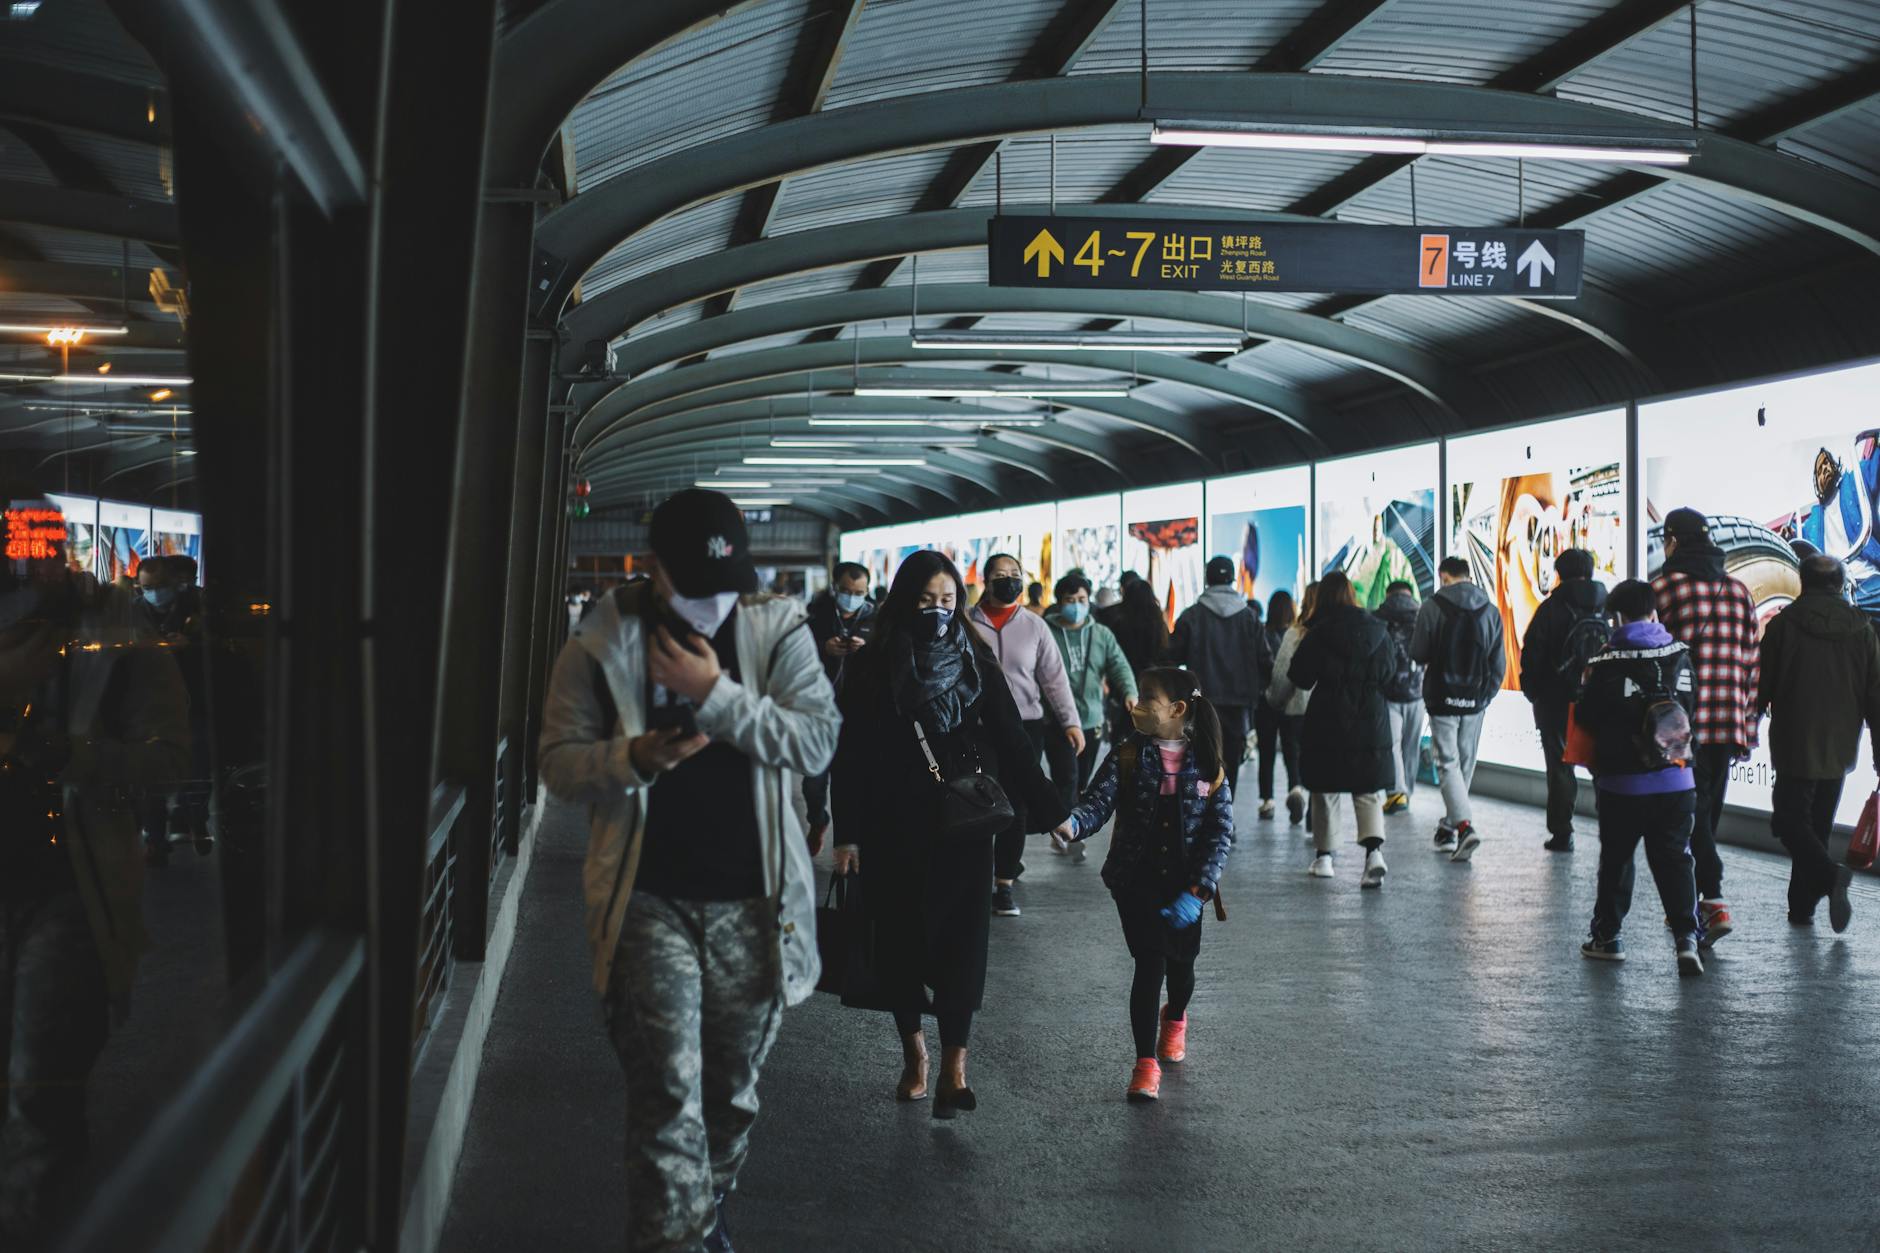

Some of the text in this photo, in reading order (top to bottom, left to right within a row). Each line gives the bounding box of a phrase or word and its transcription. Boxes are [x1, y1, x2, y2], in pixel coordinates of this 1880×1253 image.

[1162, 233, 1212, 261] 出口
[1221, 235, 1262, 249] 镇坪路
[1425, 241, 1507, 275] 7 号线
[1161, 265, 1200, 279] EXIT
[1220, 260, 1275, 274] 光复西路
[1451, 274, 1494, 287] LINE 7
[1731, 764, 1754, 784] one
[1756, 762, 1767, 786] 11
